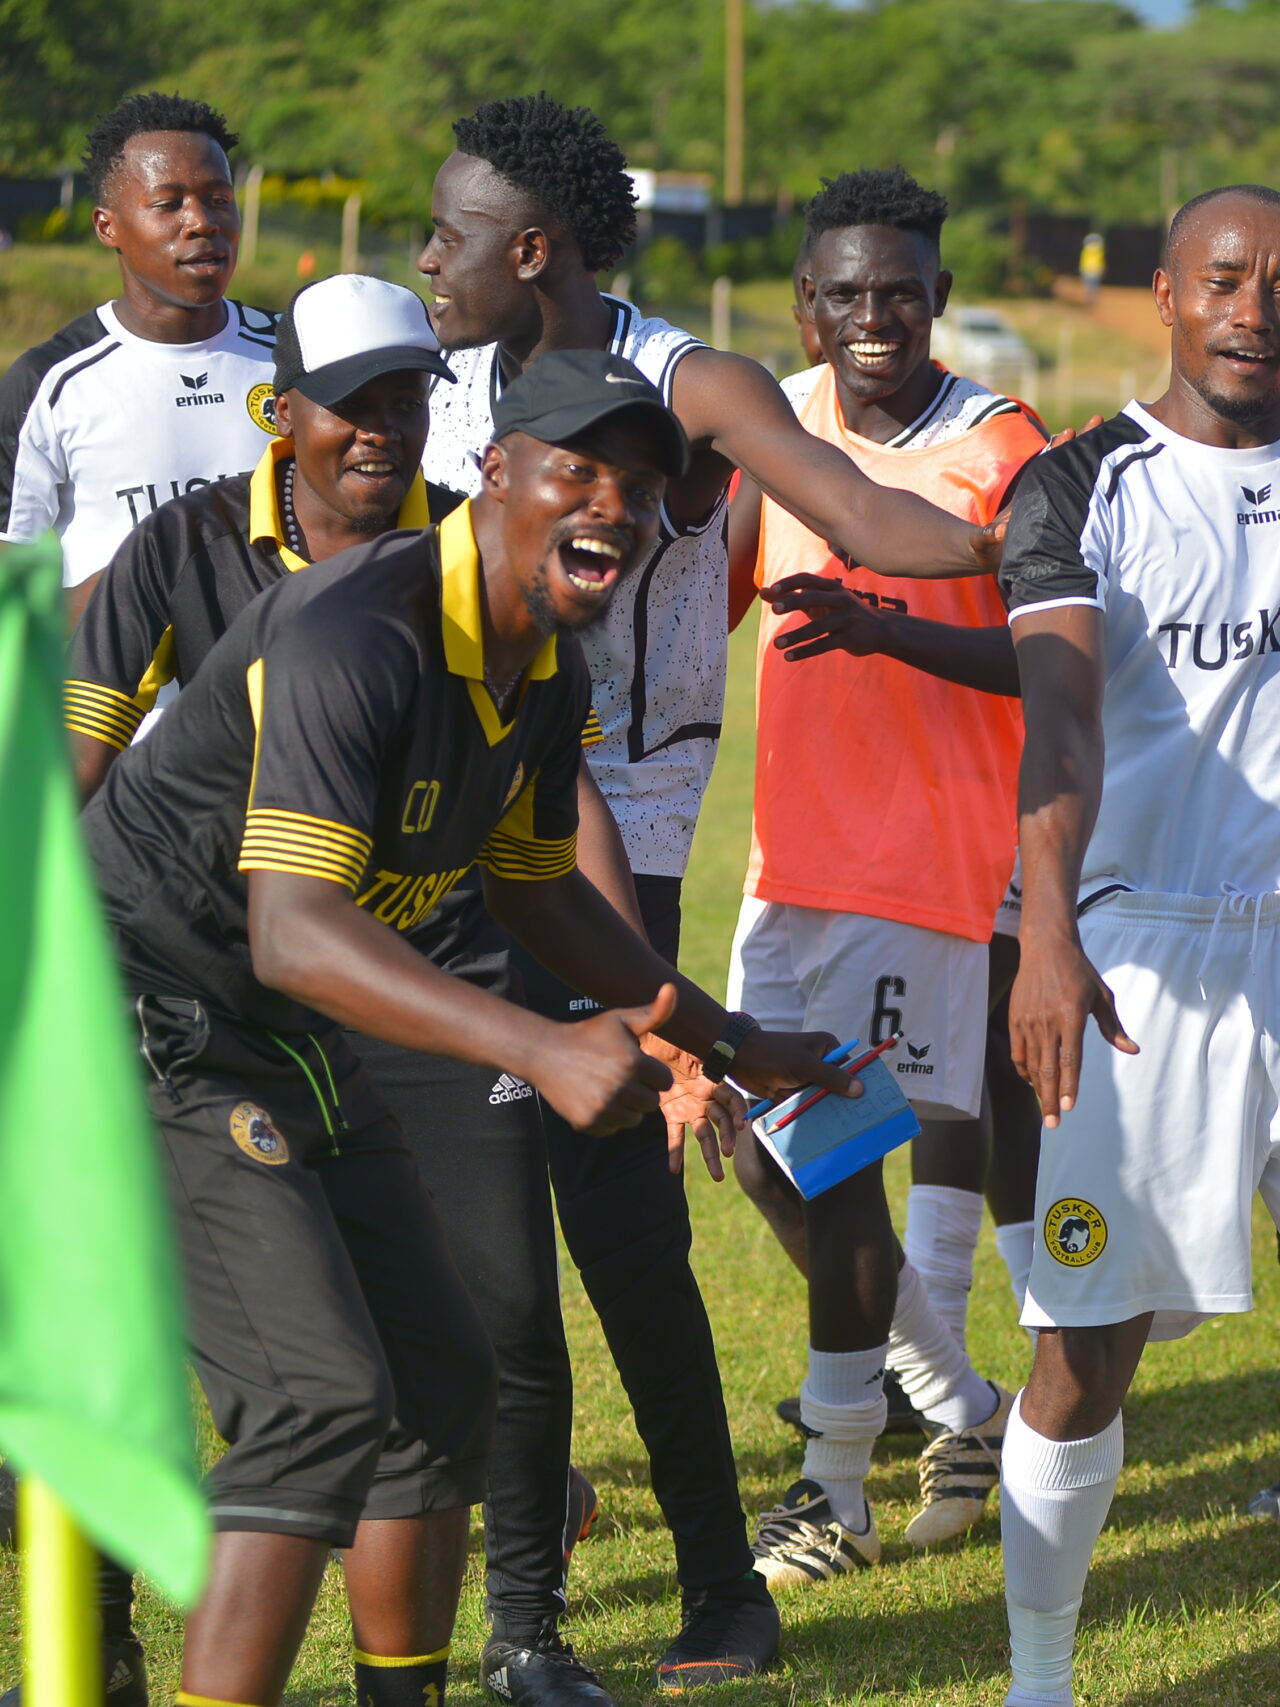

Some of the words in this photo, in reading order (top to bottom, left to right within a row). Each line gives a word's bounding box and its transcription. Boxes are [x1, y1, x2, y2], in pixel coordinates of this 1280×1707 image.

[176, 393, 225, 407] erima
[871, 975, 906, 1049] 6
[897, 1061, 934, 1075] erima
[489, 1086, 532, 1104] adidas
[1049, 1204, 1102, 1229] TUSKER
[1086, 1242, 1101, 1258] CLUB
